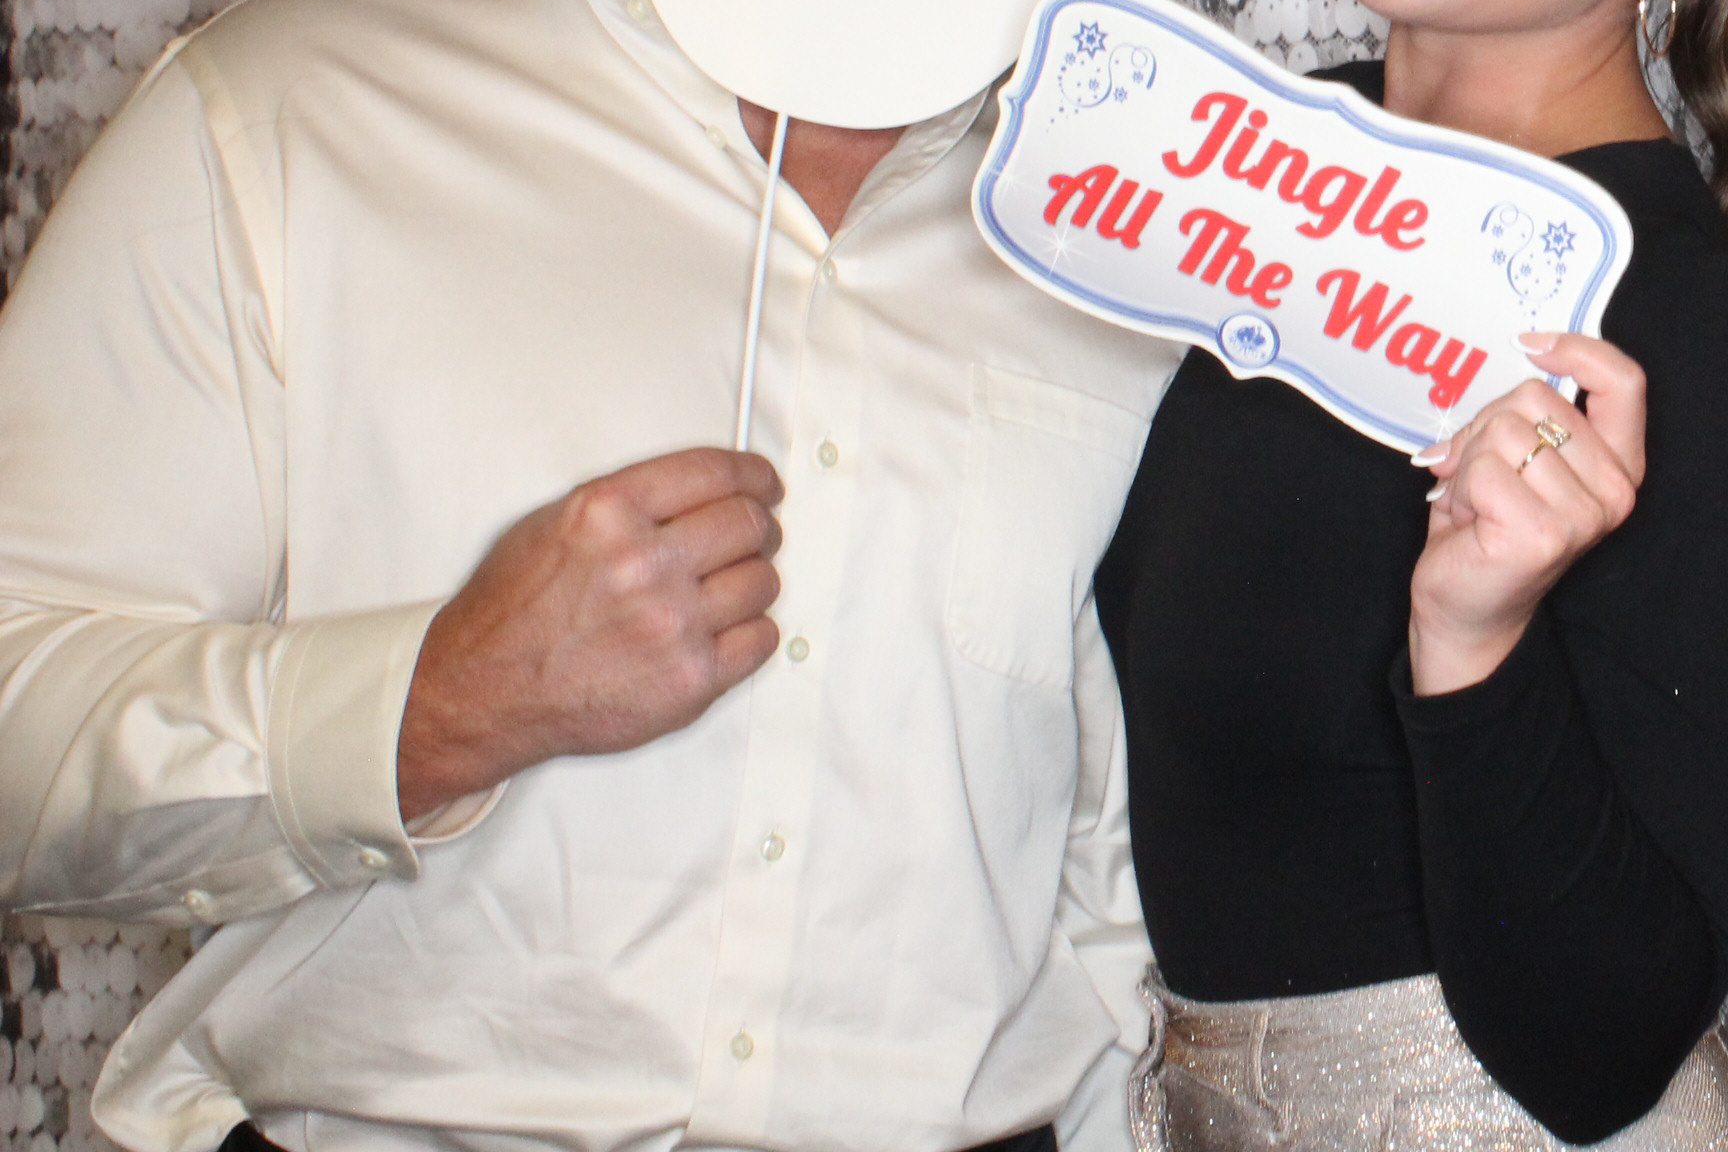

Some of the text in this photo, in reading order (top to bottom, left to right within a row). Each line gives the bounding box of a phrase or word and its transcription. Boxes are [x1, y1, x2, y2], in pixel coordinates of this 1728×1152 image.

[1161, 91, 1429, 251] Jingle
[1043, 163, 1489, 409] All The Way
